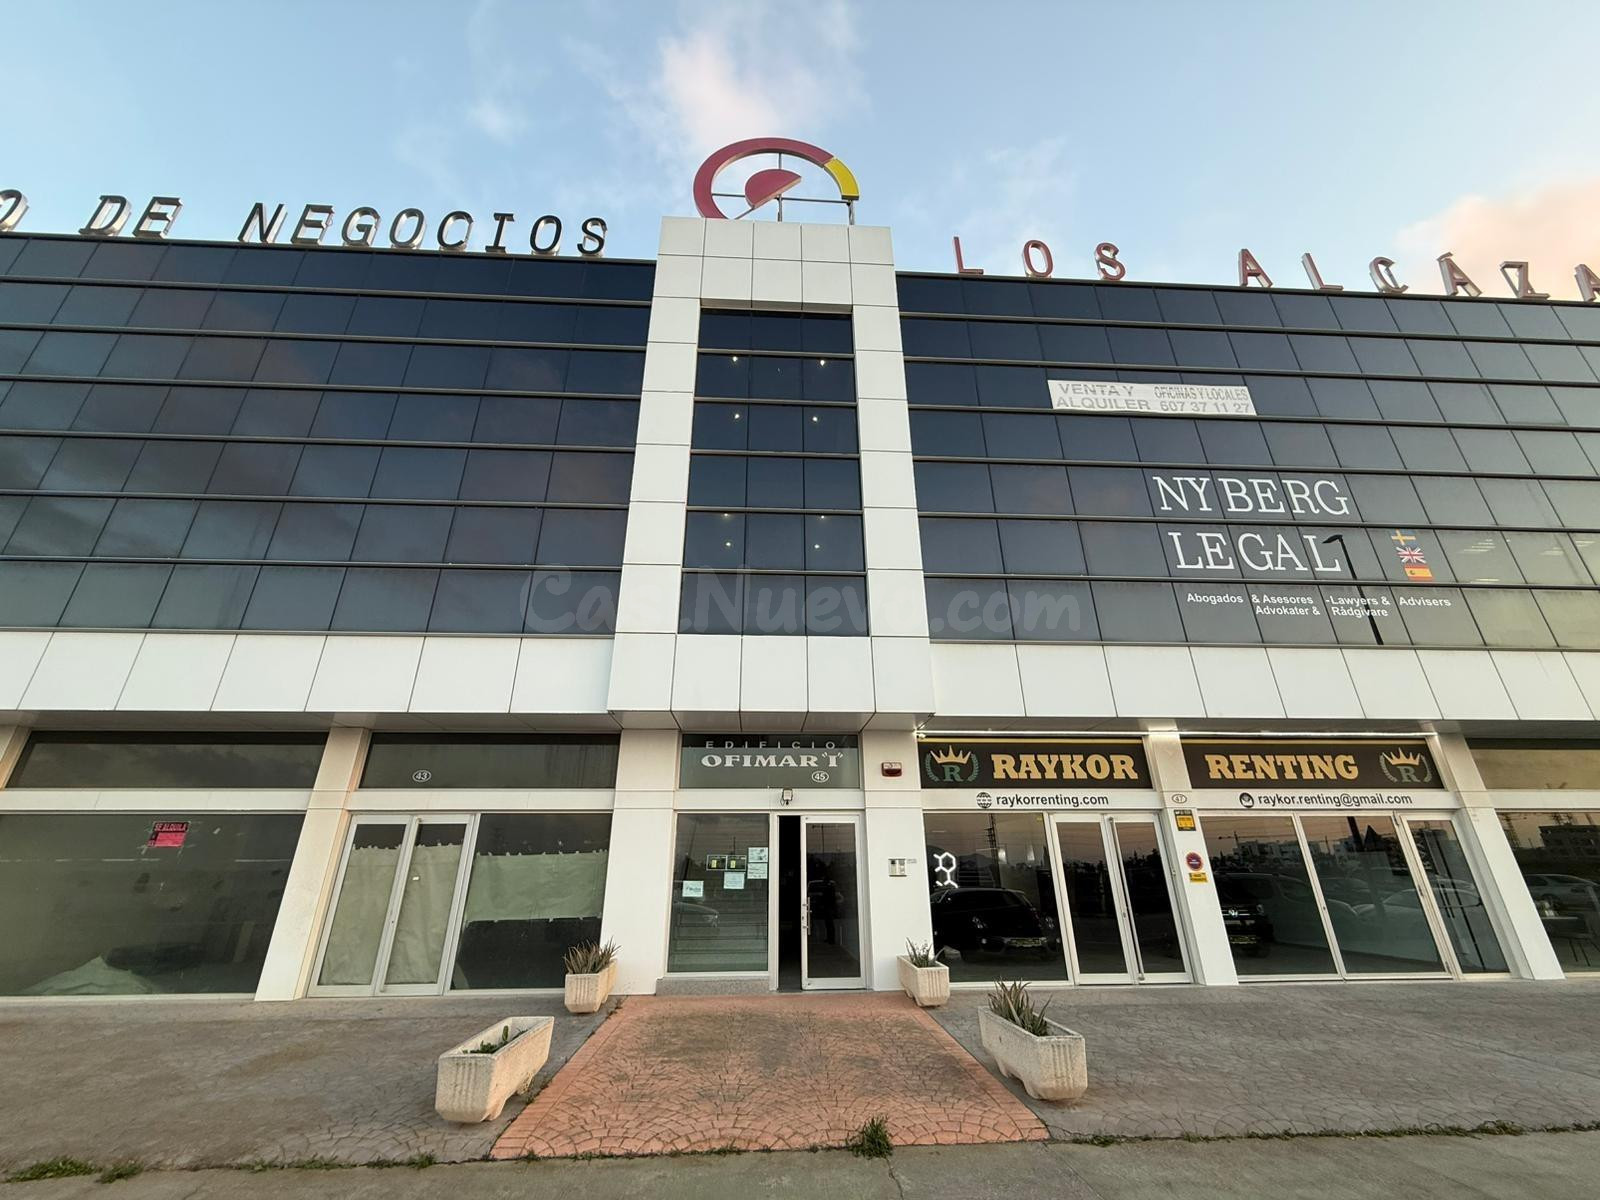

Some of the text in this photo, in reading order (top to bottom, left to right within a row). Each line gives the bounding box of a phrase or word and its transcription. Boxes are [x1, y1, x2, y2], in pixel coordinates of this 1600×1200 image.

[78, 195, 182, 239] DE
[237, 201, 608, 257] NEGOCIOS
[953, 236, 1126, 281] LOS
[1059, 383, 1133, 397] VENTA Y
[1207, 388, 1249, 401] LOCALES
[1057, 397, 1250, 414] ALQUILER 607 37 11 27
[1153, 476, 1350, 515] NYBERG
[1168, 532, 1341, 572] LEGAL
[1187, 593, 1244, 604] Abogados
[1251, 594, 1260, 604] &
[1263, 594, 1314, 605] Asesores
[1381, 596, 1390, 606] &
[1399, 597, 1452, 607] Advisers
[1255, 605, 1309, 616] Advokater
[1312, 606, 1320, 616] &
[705, 740, 836, 750] EDIFICIO
[701, 754, 818, 768] OFIMAR
[991, 754, 1139, 780] RAYKOR
[1204, 754, 1359, 780] RENTING
[415, 772, 428, 780] 43
[813, 771, 828, 782] 45
[943, 765, 962, 782] R
[1399, 766, 1421, 783] R
[996, 793, 1109, 807] raykorrenting.com
[1258, 793, 1413, 807] raykor.renting@gmail.com
